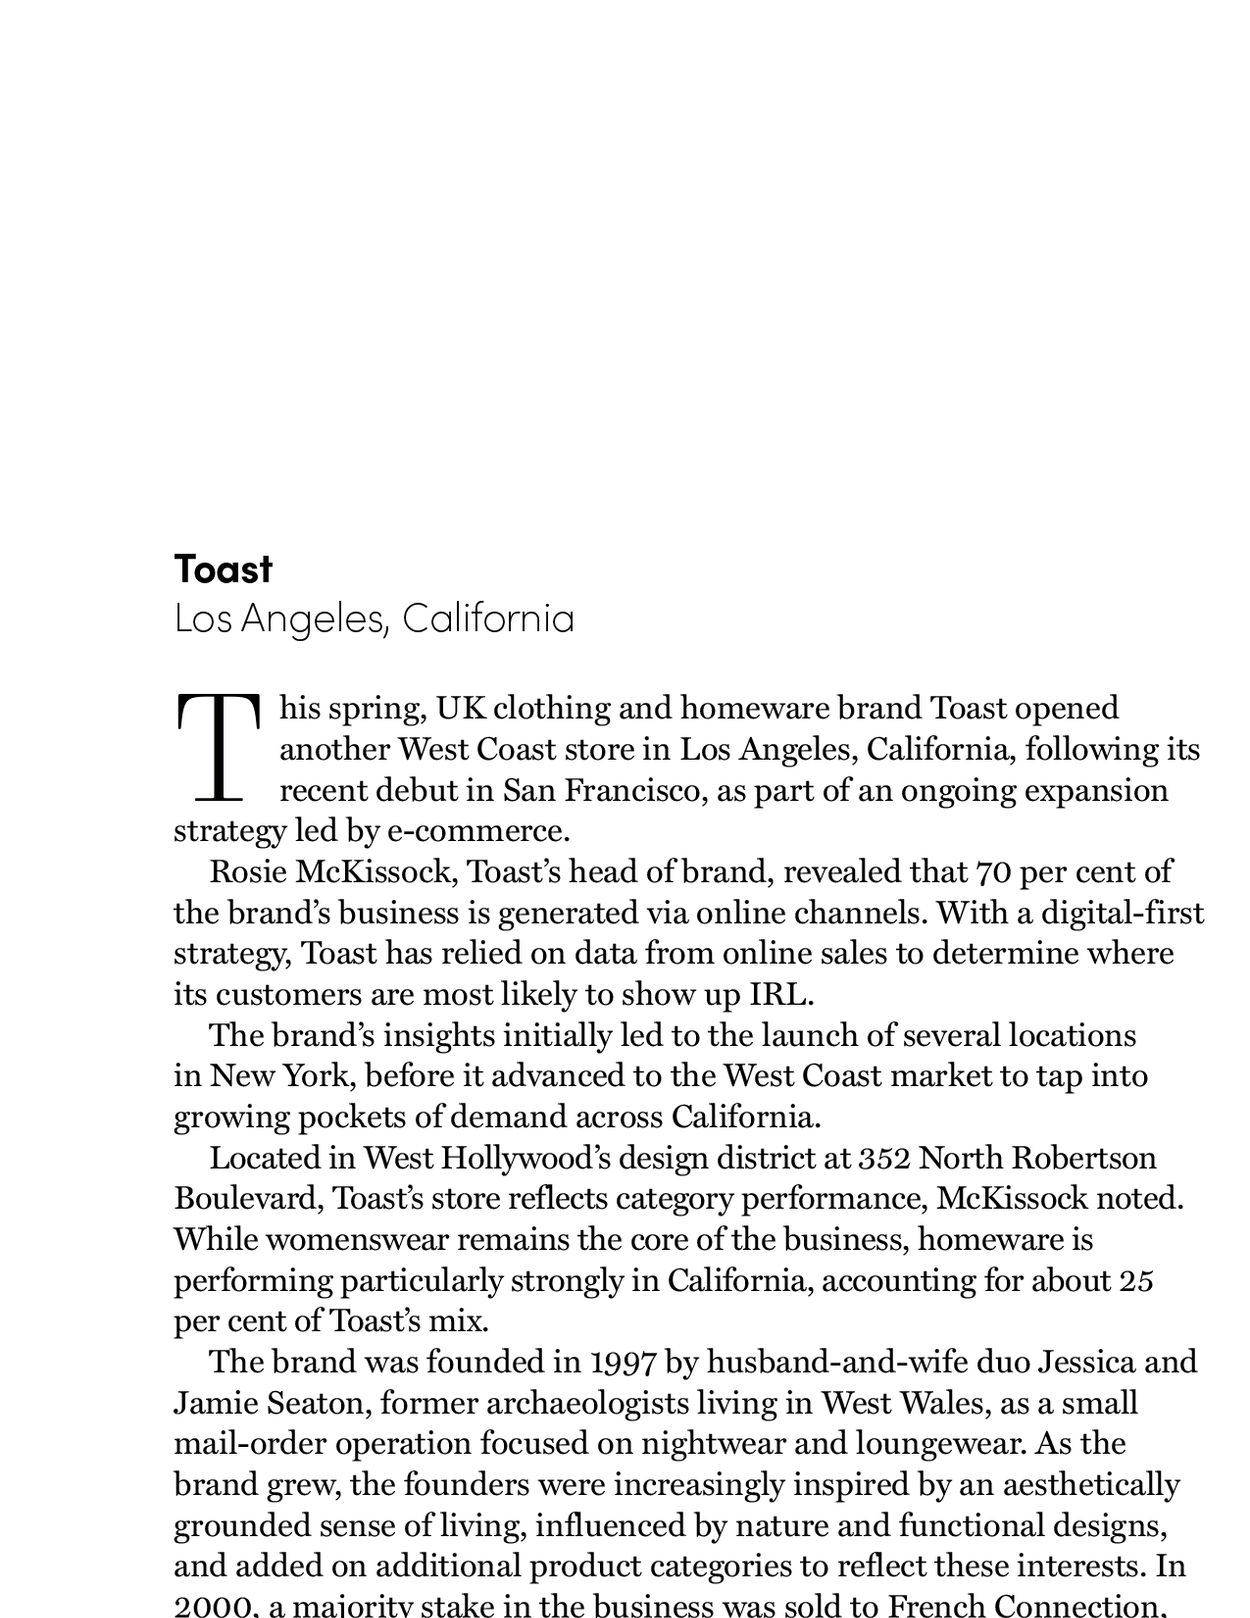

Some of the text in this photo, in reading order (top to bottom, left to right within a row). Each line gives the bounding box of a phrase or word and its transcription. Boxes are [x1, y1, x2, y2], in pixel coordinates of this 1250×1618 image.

[174, 554, 273, 583] Toast
[177, 601, 573, 641] Los Angeles, California
[329, 695, 426, 726] spring,
[437, 696, 487, 719] UK
[494, 694, 611, 726] clothing
[620, 694, 672, 719] and
[681, 694, 829, 719] homeware
[837, 694, 922, 719] brand
[930, 696, 1007, 719] Toast
[1016, 694, 1119, 726] opened
[175, 817, 569, 849] strategy led by e-commerce.
[174, 980, 813, 1012] its customers are most likely to show up IRL.
[174, 1103, 820, 1135] growing pockets of demand across California.
[175, 1184, 1183, 1216] Boulevard, Toast’s store reflects category performance, McKissock noted.
[175, 1429, 1126, 1461] mail-order operation focused on nightwear and loungewear. As the
